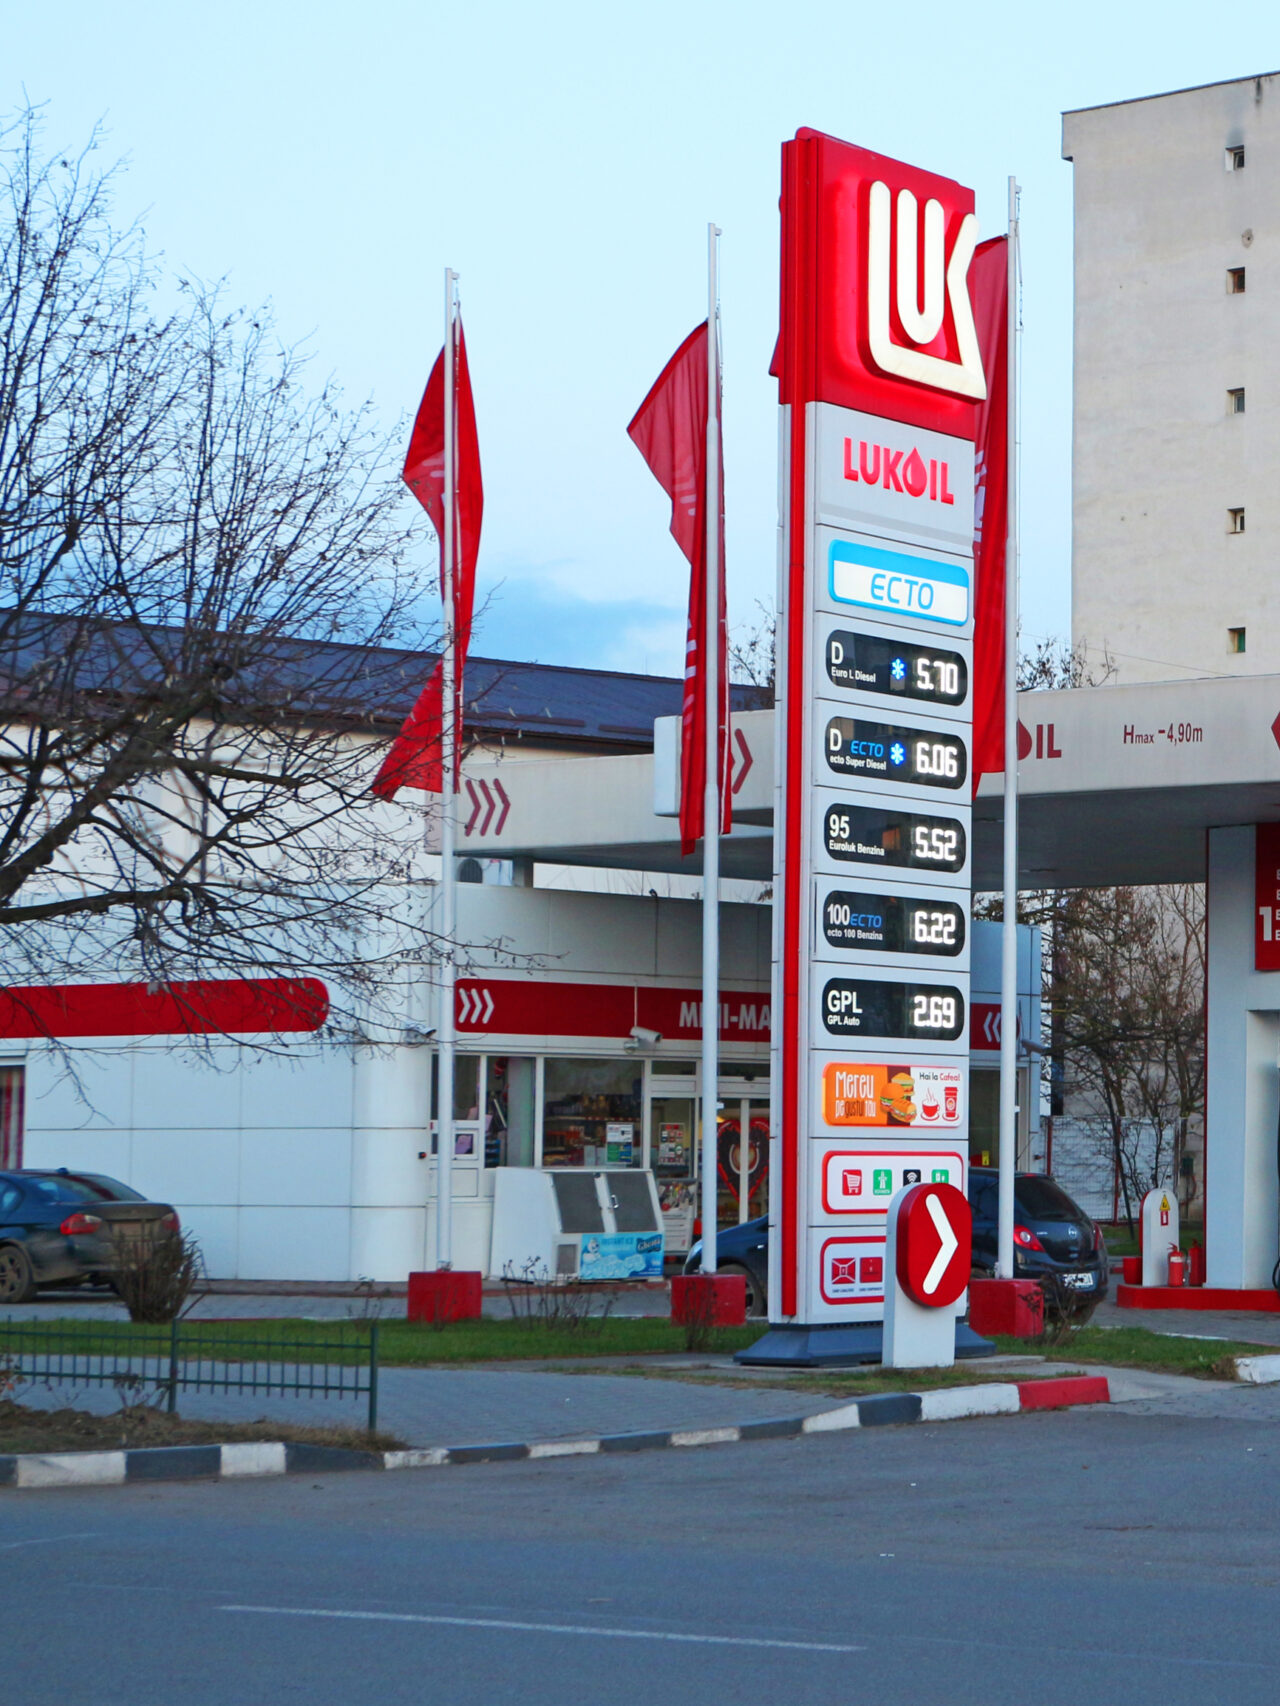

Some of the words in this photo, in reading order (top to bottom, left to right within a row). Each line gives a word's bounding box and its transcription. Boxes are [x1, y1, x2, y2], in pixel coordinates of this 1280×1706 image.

[868, 180, 987, 400] LUK
[843, 437, 955, 505] LUKOIL
[870, 573, 934, 609] ECTO
[831, 641, 844, 665] D
[831, 667, 848, 679] Euro
[849, 669, 854, 680] L
[855, 671, 876, 683] Diesel
[916, 658, 958, 695] 5.70
[829, 728, 842, 751] D
[850, 740, 884, 758] ECTO
[1123, 724, 1154, 744] Hmax
[829, 755, 844, 765] ecto
[845, 756, 865, 768] Super
[866, 759, 887, 771] Diesel
[916, 742, 957, 778] 6.06
[829, 814, 850, 839] 95
[829, 840, 856, 853] Euroluk
[857, 843, 885, 856] Benzina
[915, 826, 957, 861] 5.52
[827, 903, 849, 926] 100
[850, 913, 882, 928] ECTO
[914, 910, 956, 945] 6.22
[1259, 906, 1272, 941] 1
[827, 929, 842, 938] ecto
[844, 929, 855, 938] 100
[857, 930, 883, 941] Benzina
[827, 989, 863, 1013] GPL
[914, 995, 956, 1029] 2.69
[827, 1015, 843, 1025] GPL
[844, 1016, 860, 1026] Auto
[835, 1071, 875, 1099] Mereu
[920, 1072, 931, 1080] Hai
